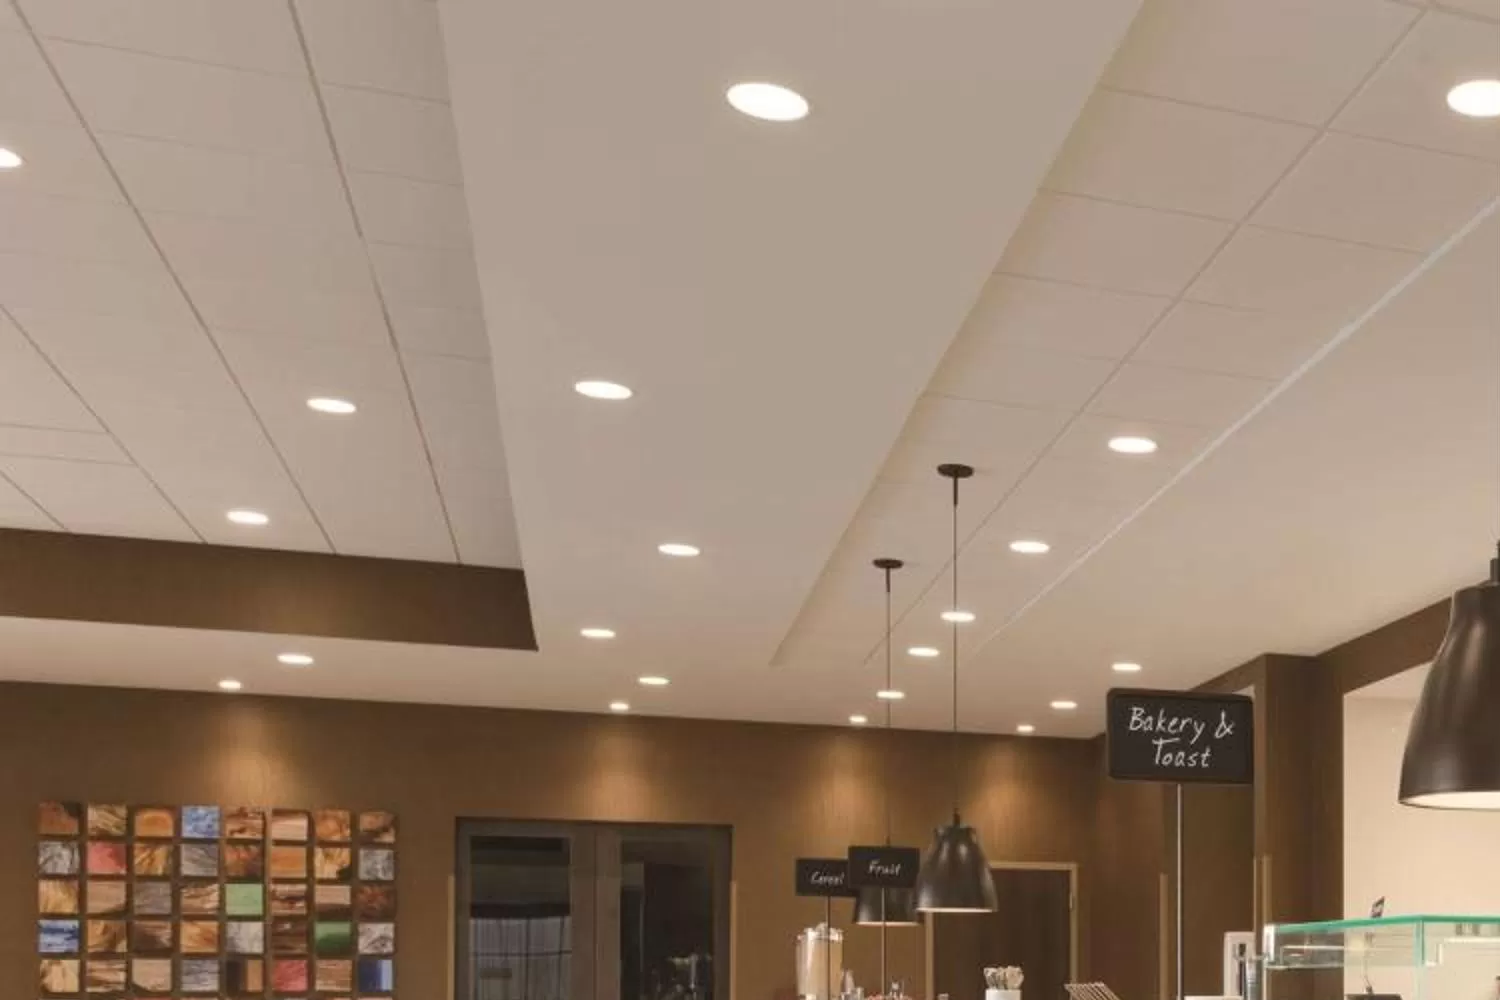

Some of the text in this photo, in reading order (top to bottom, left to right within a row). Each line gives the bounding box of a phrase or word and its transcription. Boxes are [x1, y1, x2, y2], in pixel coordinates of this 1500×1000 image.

[1127, 705, 1235, 745] Bakery &
[1151, 736, 1212, 768] Toast
